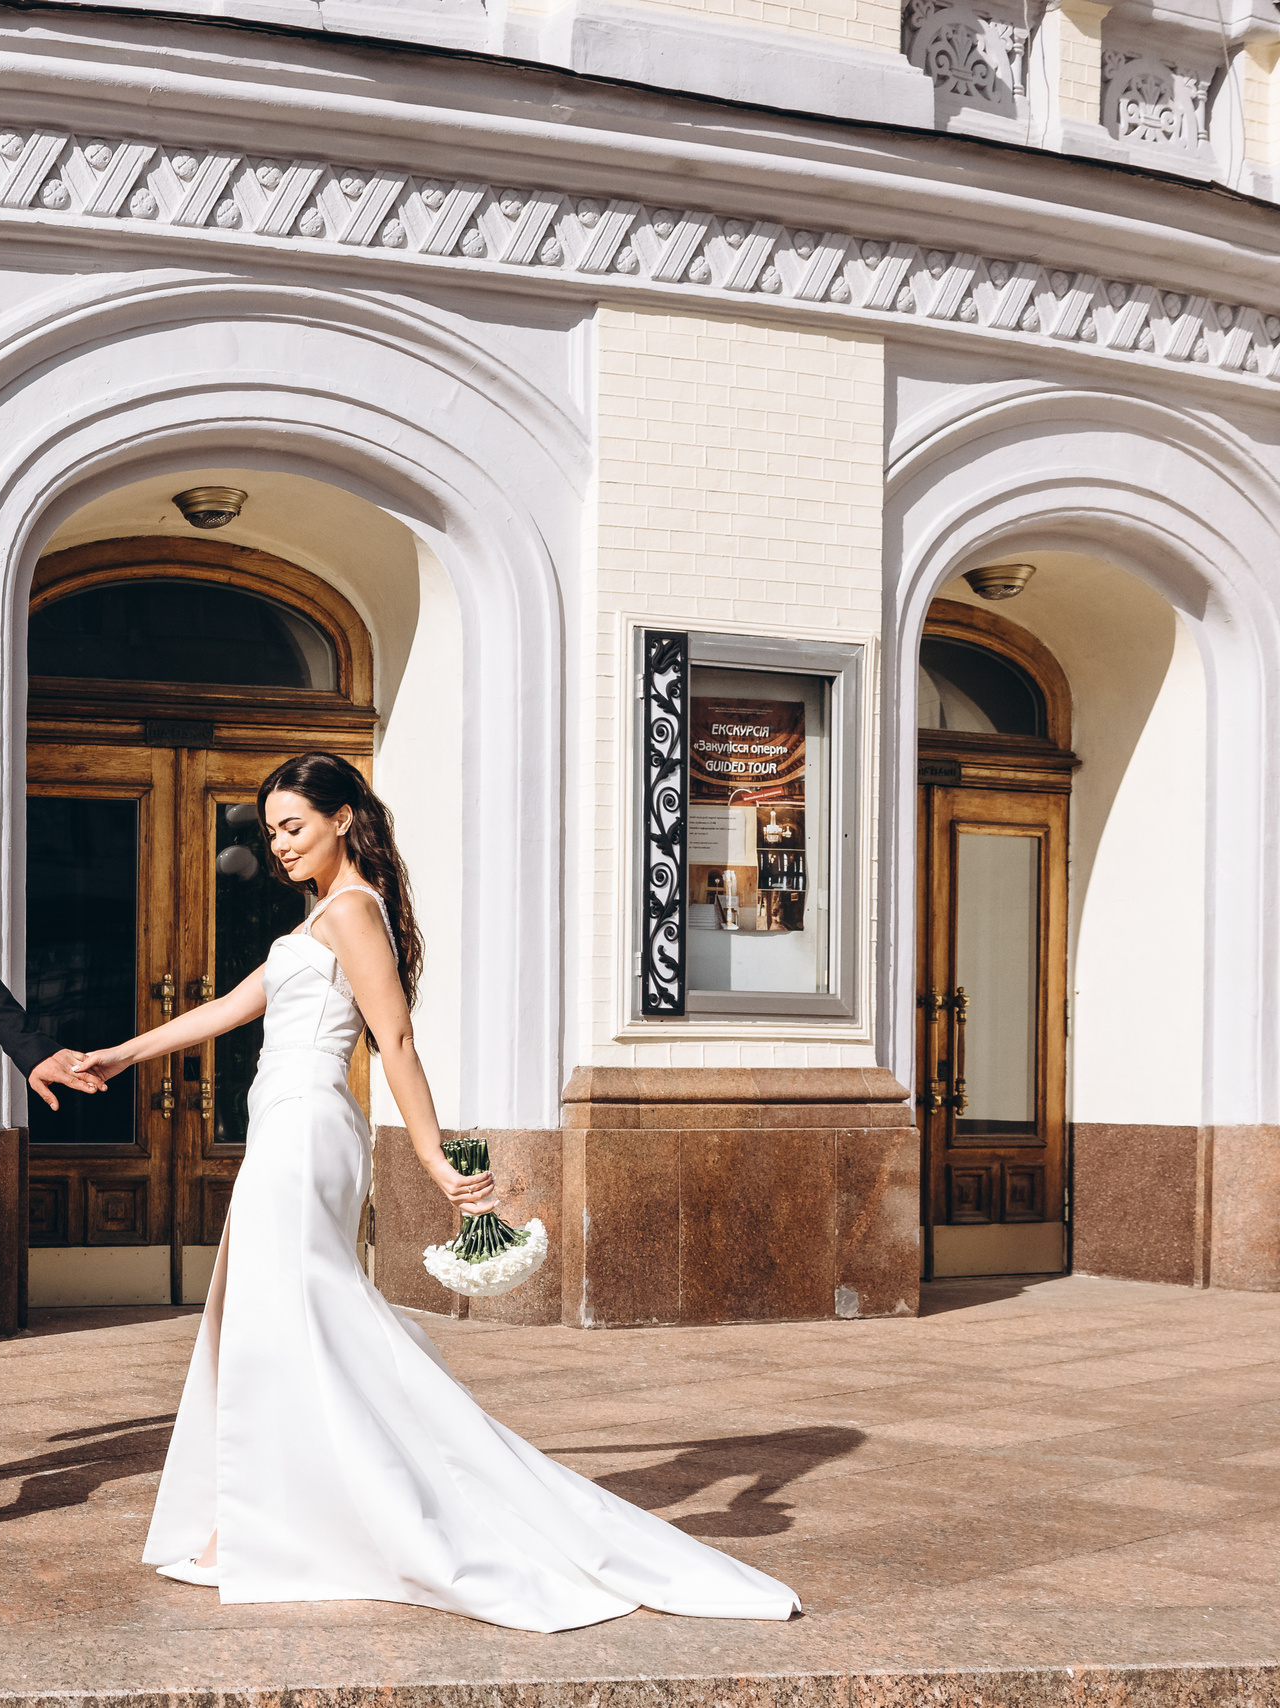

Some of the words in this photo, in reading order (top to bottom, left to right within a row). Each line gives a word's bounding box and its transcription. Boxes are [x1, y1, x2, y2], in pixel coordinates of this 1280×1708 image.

[711, 723, 770, 738] ЕКСКУРСІЯ
[694, 740, 749, 754] «Закулісся
[751, 744, 788, 757] опери»
[705, 760, 746, 773] GUIDED
[747, 762, 777, 774] TOUR
